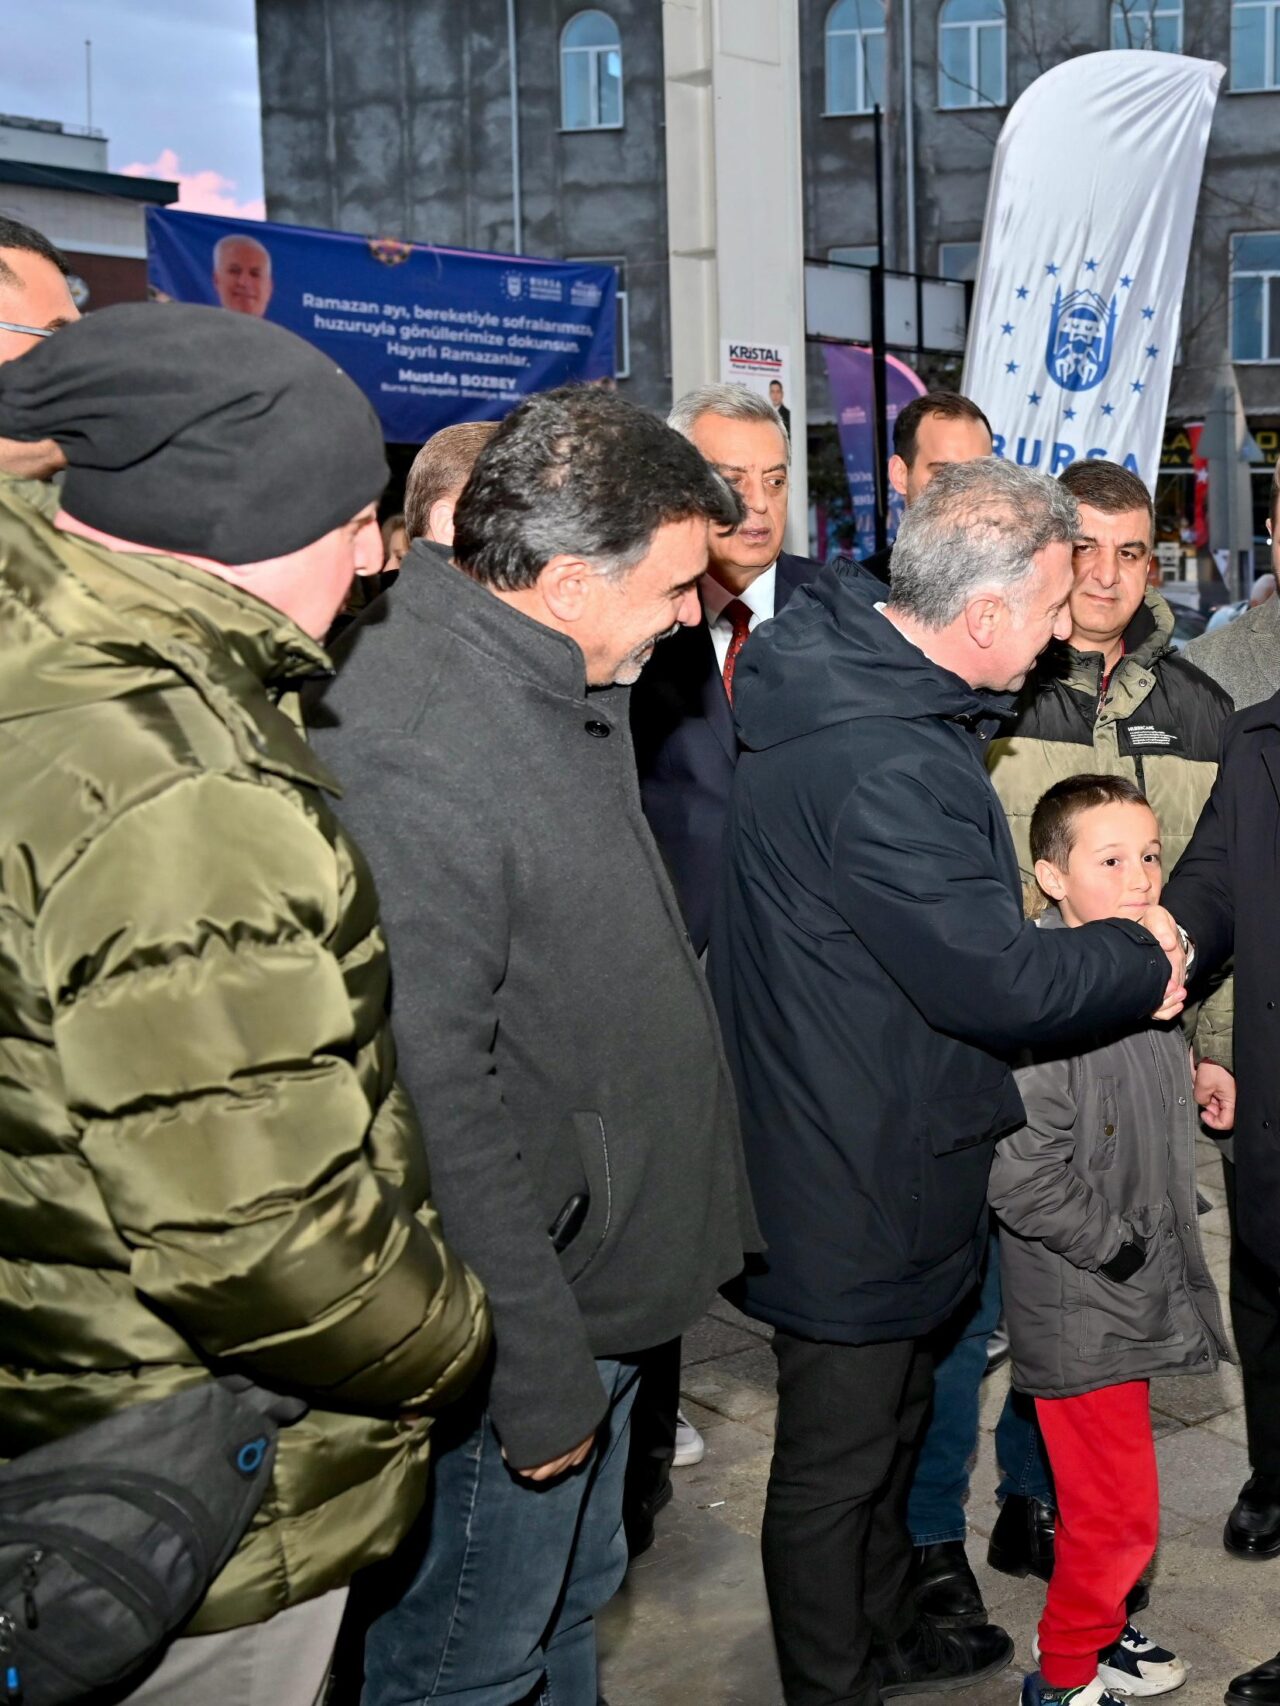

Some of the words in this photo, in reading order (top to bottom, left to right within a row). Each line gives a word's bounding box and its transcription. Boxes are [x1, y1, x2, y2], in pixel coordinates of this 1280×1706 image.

[302, 292, 380, 315] Ramazan
[382, 304, 411, 320] ayı,
[413, 304, 500, 328] bereketiyle
[313, 314, 396, 338] huzuruyla
[399, 323, 504, 346] gönüllerimize
[386, 341, 438, 360] Hayırlı
[440, 346, 531, 368] Ramazanlar.
[398, 368, 457, 386] Mustafa
[460, 373, 516, 390] BOZBEY
